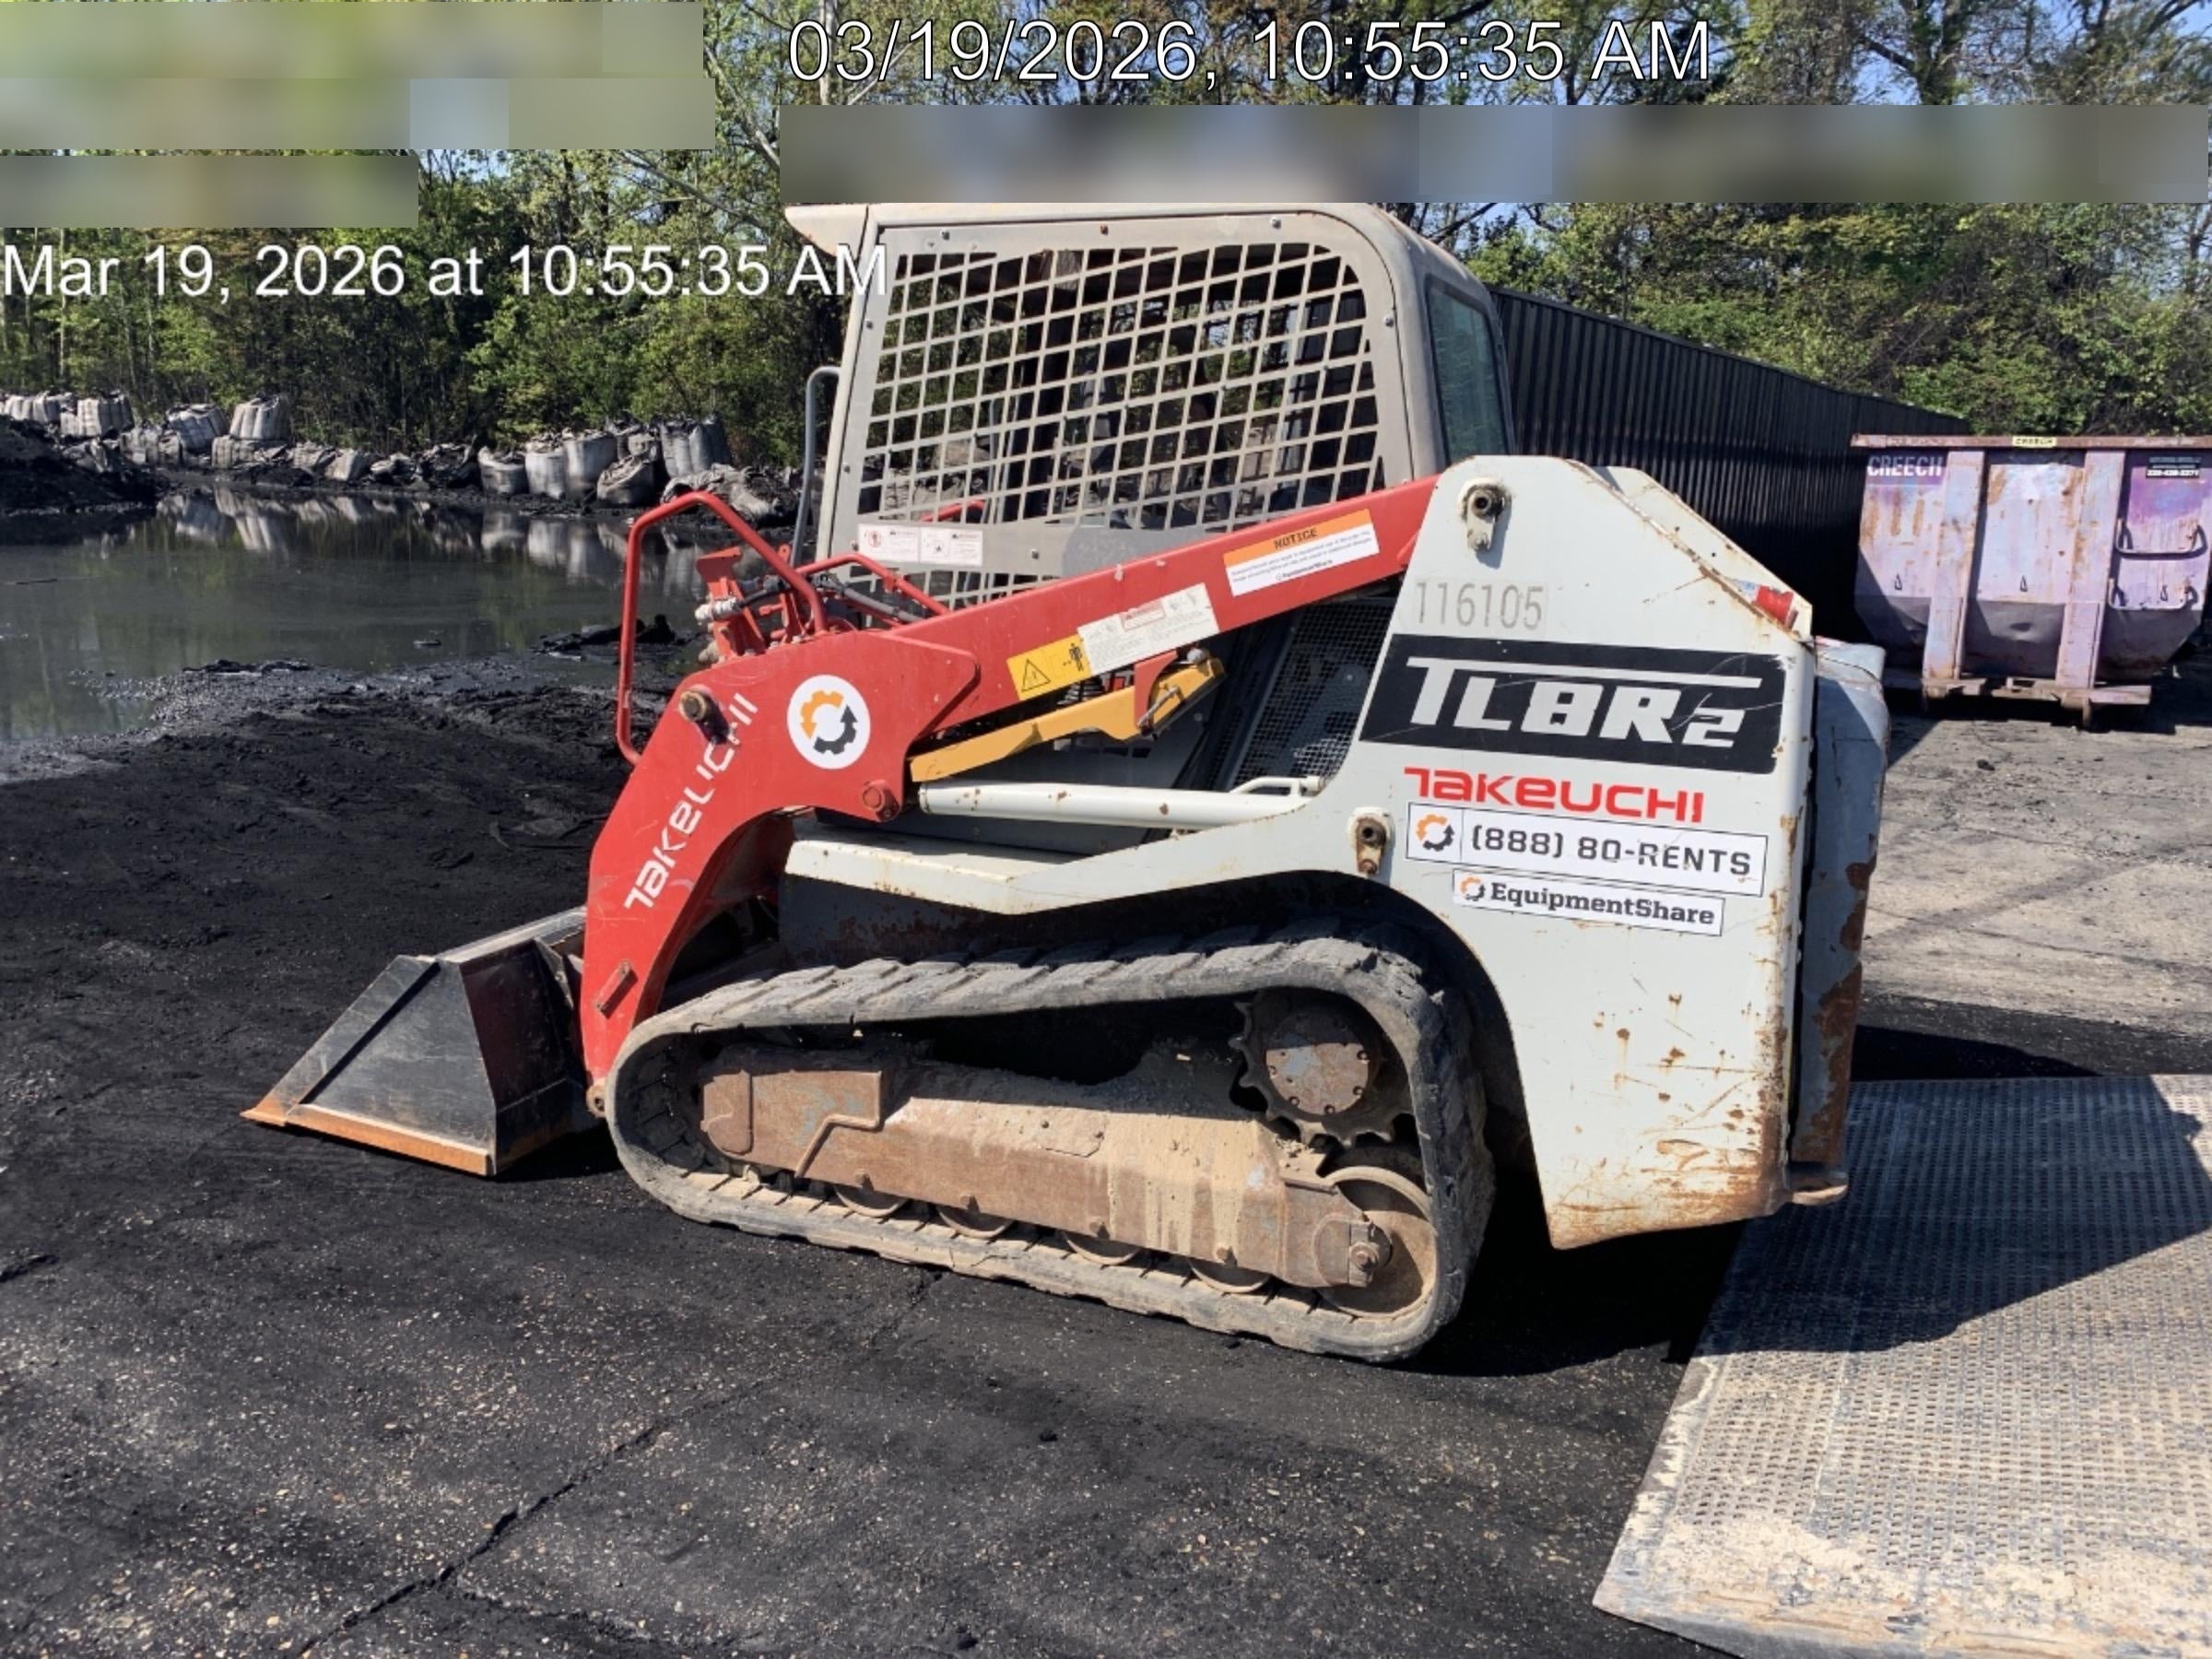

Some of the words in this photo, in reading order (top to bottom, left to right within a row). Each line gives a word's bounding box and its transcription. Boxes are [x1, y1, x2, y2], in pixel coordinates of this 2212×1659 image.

[1866, 454, 1944, 477] CREECH
[1416, 581, 1544, 631] 116105
[1471, 824, 1565, 858] (888)
[1577, 837, 1752, 877] 80-RENTS
[1489, 882, 1715, 925] EquipmentShare
